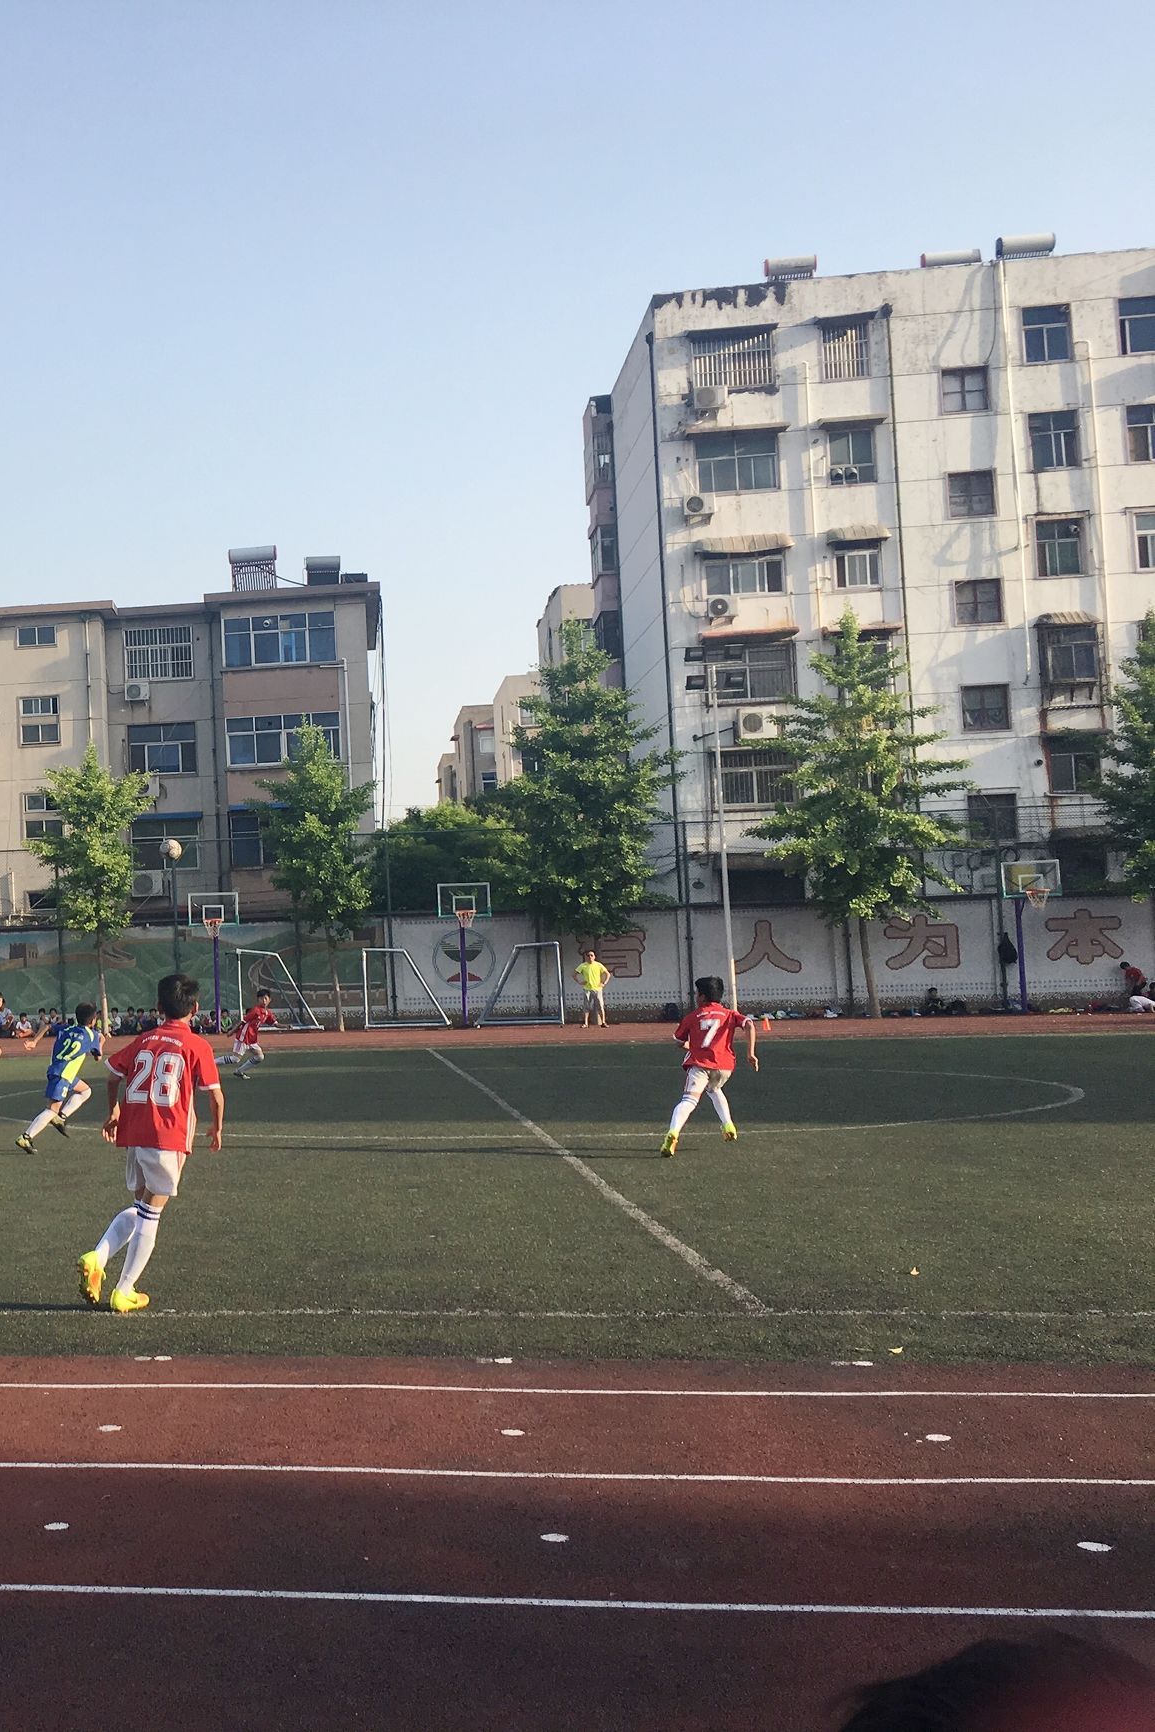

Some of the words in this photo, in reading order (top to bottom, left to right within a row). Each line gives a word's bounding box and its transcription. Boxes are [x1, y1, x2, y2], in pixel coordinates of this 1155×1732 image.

[700, 1018, 721, 1049] 7
[56, 1038, 82, 1061] 22
[126, 1050, 186, 1108] 28
